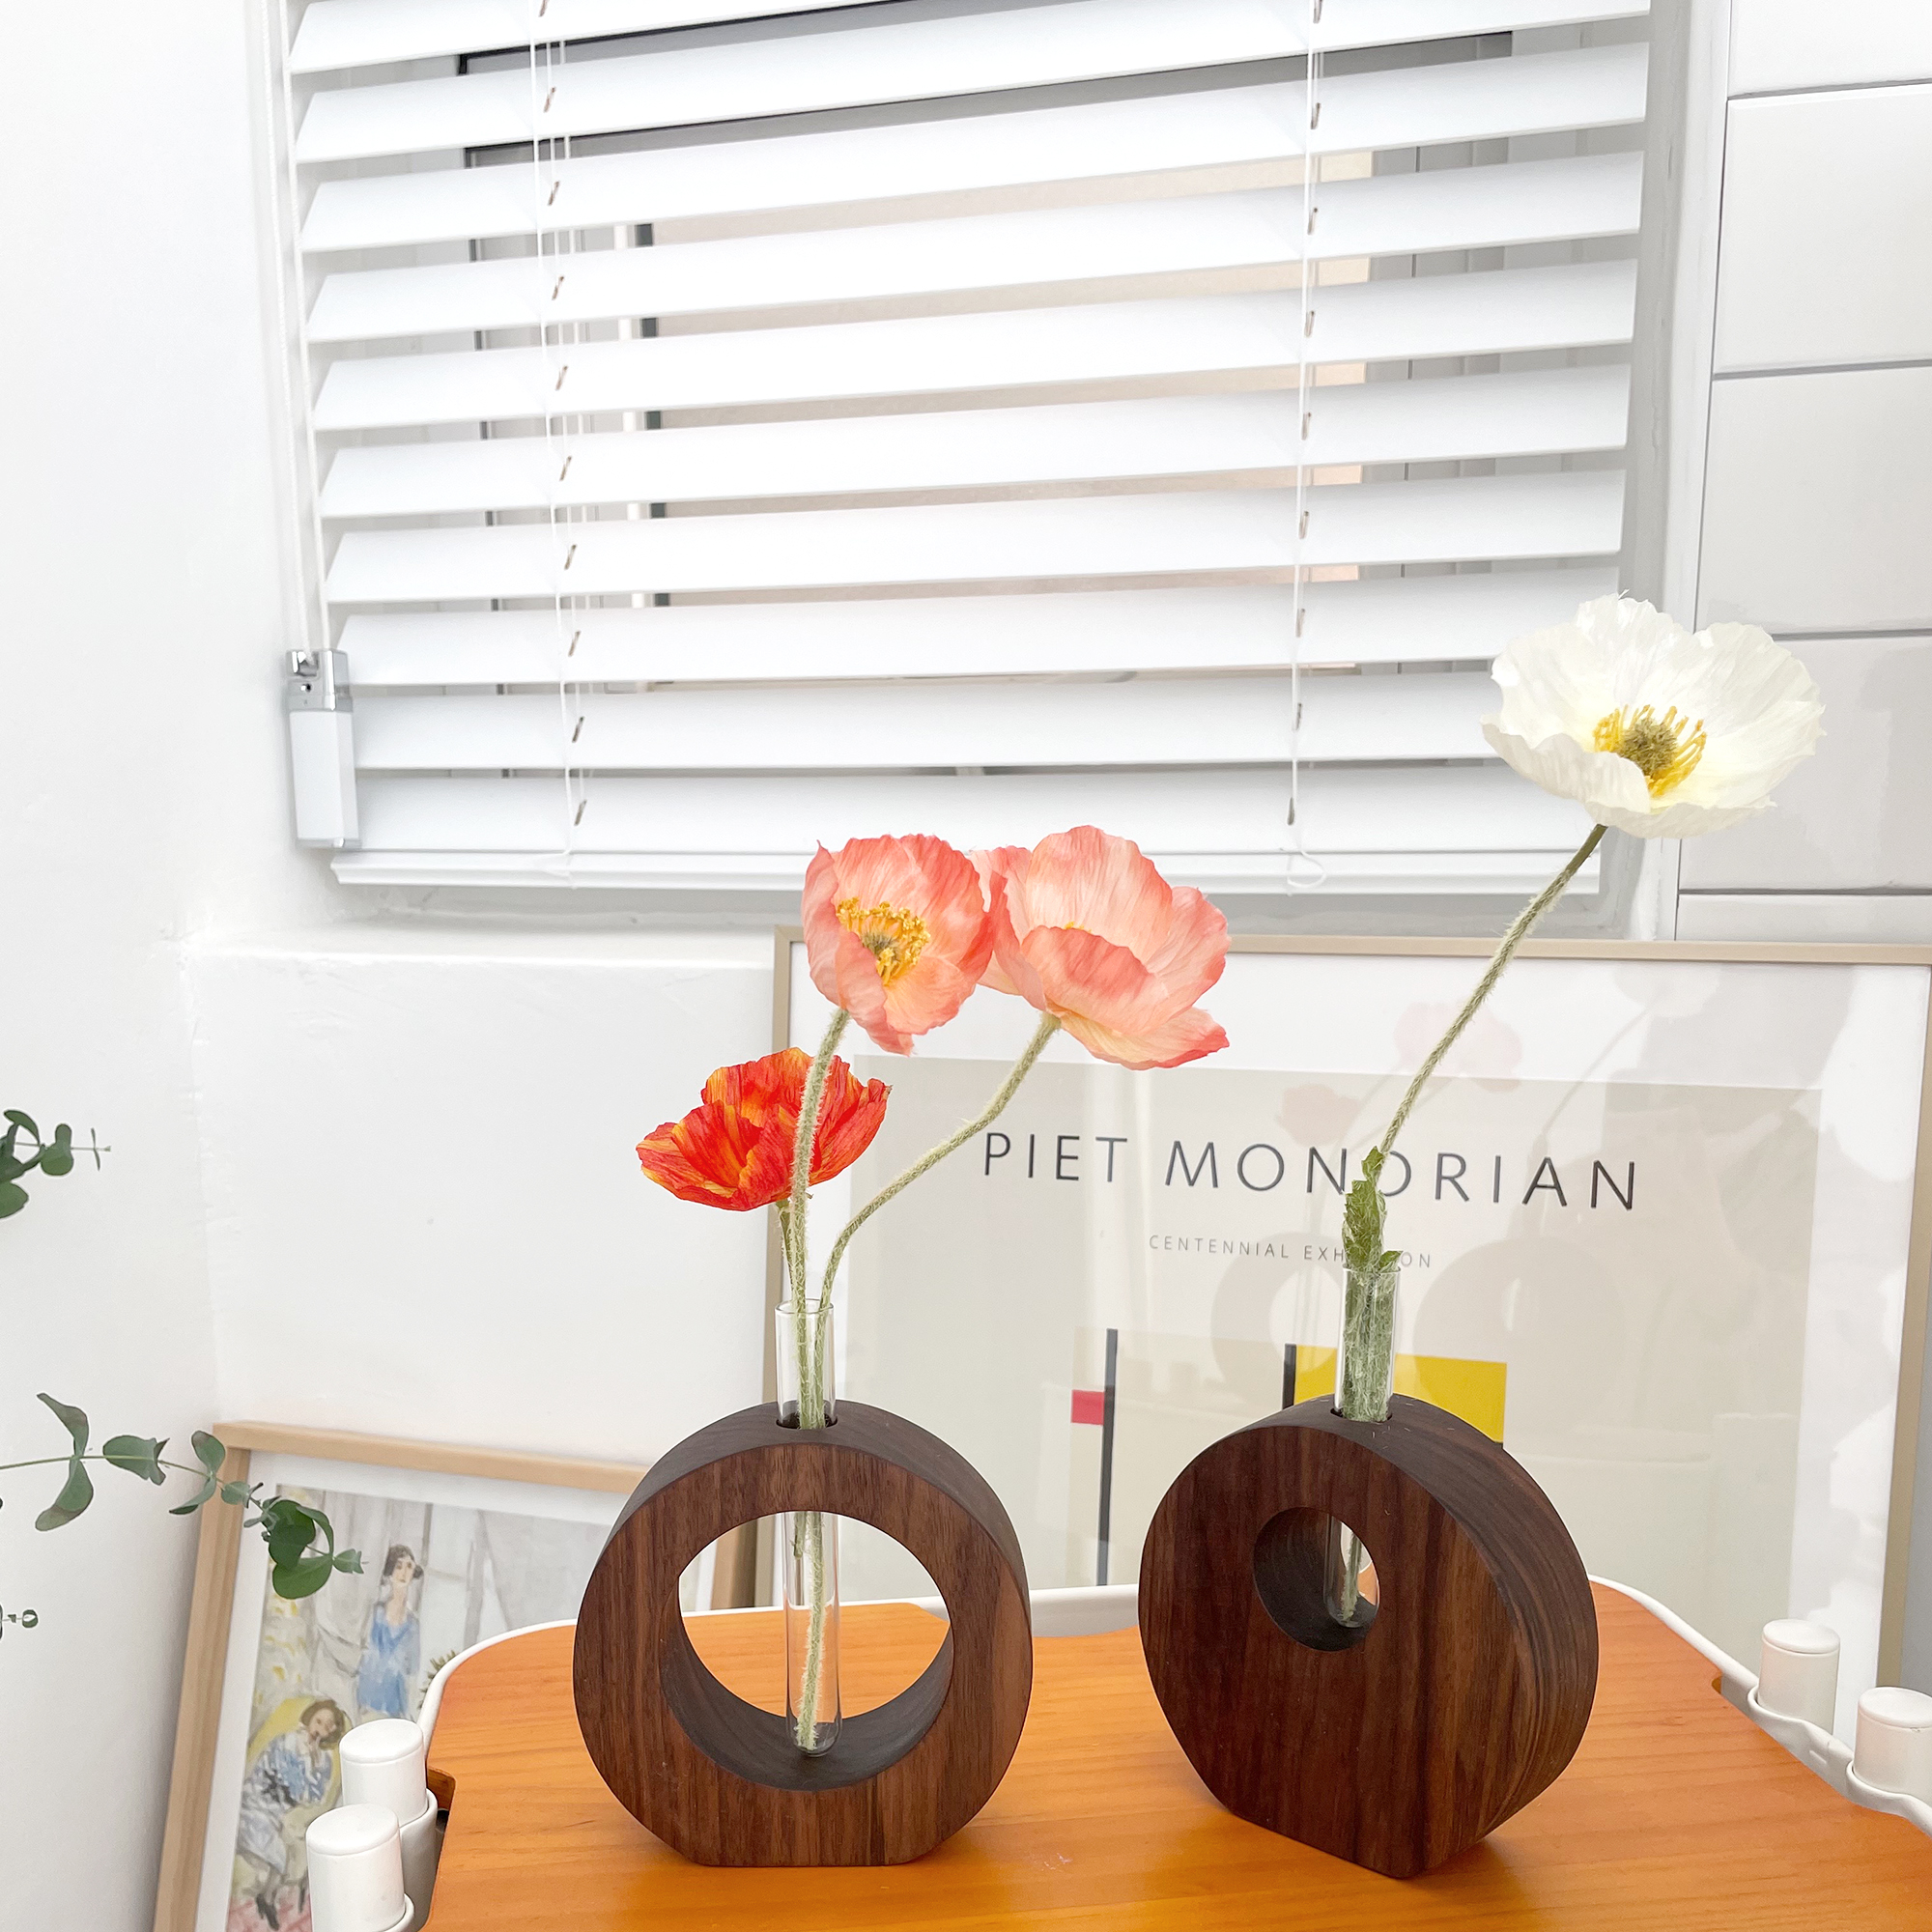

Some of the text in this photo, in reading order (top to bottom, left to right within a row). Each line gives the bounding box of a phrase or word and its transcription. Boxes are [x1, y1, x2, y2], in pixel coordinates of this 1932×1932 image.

[984, 1132, 1128, 1183] PIET
[1150, 1235, 1432, 1269] CENTENNIAL EXHON
